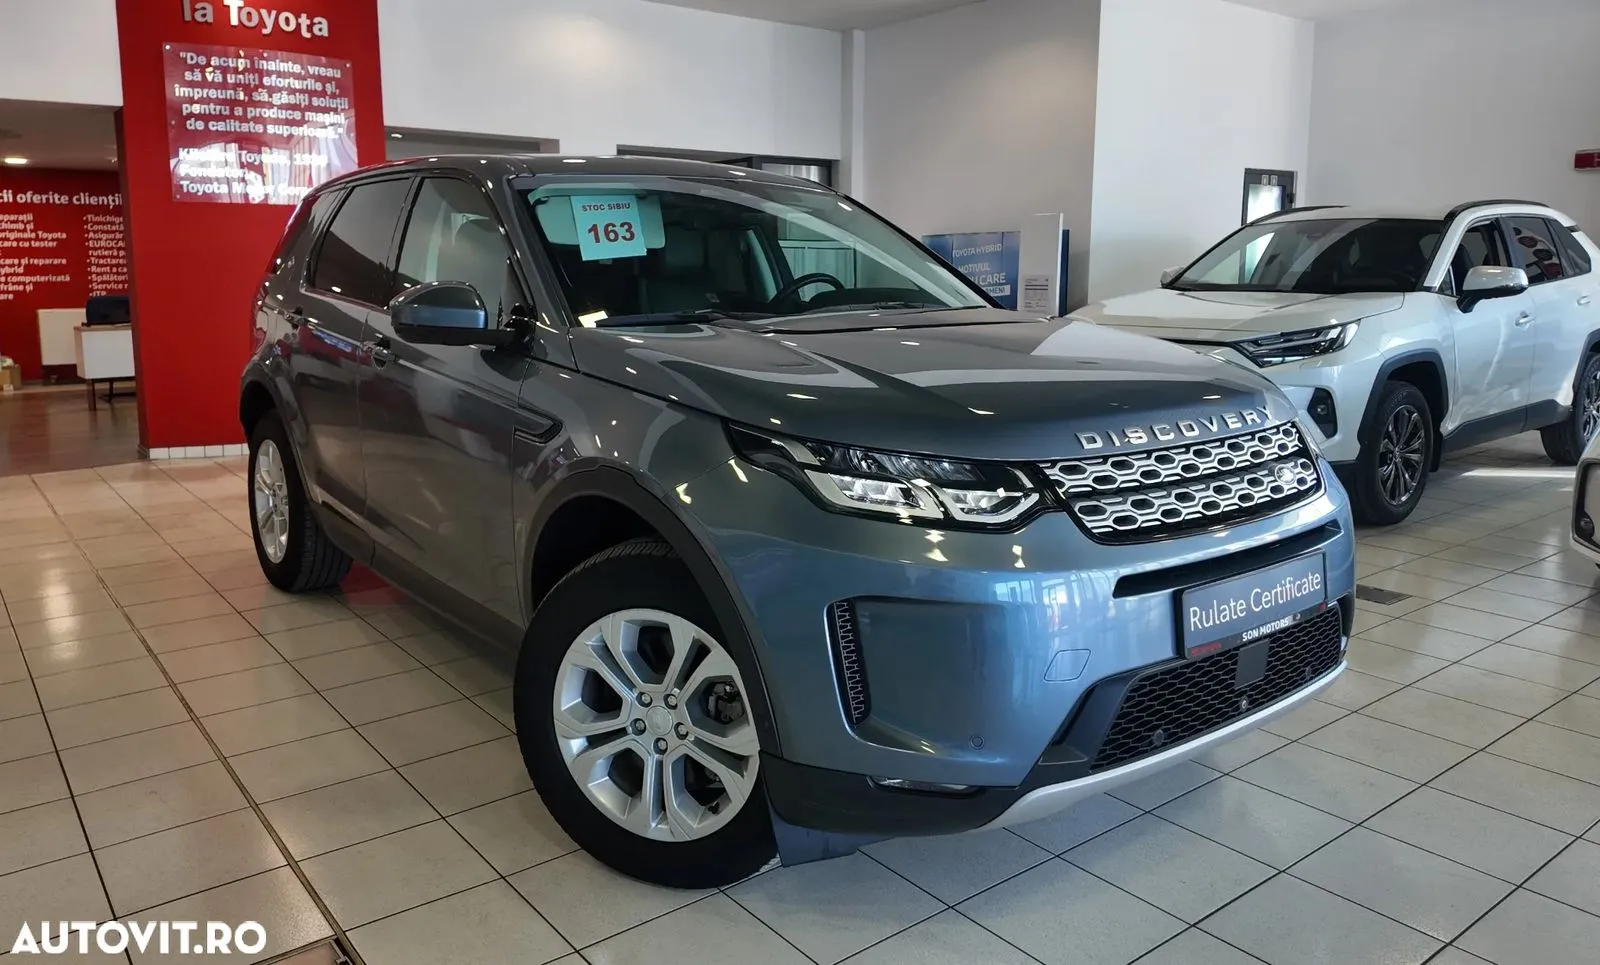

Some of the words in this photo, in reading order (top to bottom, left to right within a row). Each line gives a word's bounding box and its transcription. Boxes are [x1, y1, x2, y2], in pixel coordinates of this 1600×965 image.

[182, 0, 214, 23] la
[223, 0, 329, 38] Toyota
[210, 56, 251, 70] acum
[307, 65, 341, 78] vreau
[184, 68, 202, 81] să
[263, 74, 323, 91] eforturile
[182, 103, 230, 116] pentru
[233, 106, 243, 116] a
[247, 106, 302, 120] produce
[186, 118, 205, 130] de
[208, 119, 264, 133] calitate
[180, 181, 228, 195] Toyota
[17, 191, 69, 204] oferite
[582, 203, 605, 212] STOC
[608, 202, 631, 211] SIBIU
[37, 230, 67, 240] Toyota
[588, 221, 636, 244] 163
[31, 240, 58, 248] tester
[976, 243, 1003, 255] HYBRID
[30, 258, 67, 266] reparare
[91, 265, 110, 273] Rent
[92, 282, 122, 290] Service
[979, 272, 1007, 286] CARE
[1075, 405, 1274, 450] DISCOVERY
[1189, 599, 1247, 632] Rulate
[1250, 571, 1322, 612] Certificate
[1242, 628, 1259, 642] SON
[1259, 617, 1290, 637] MOTORS
